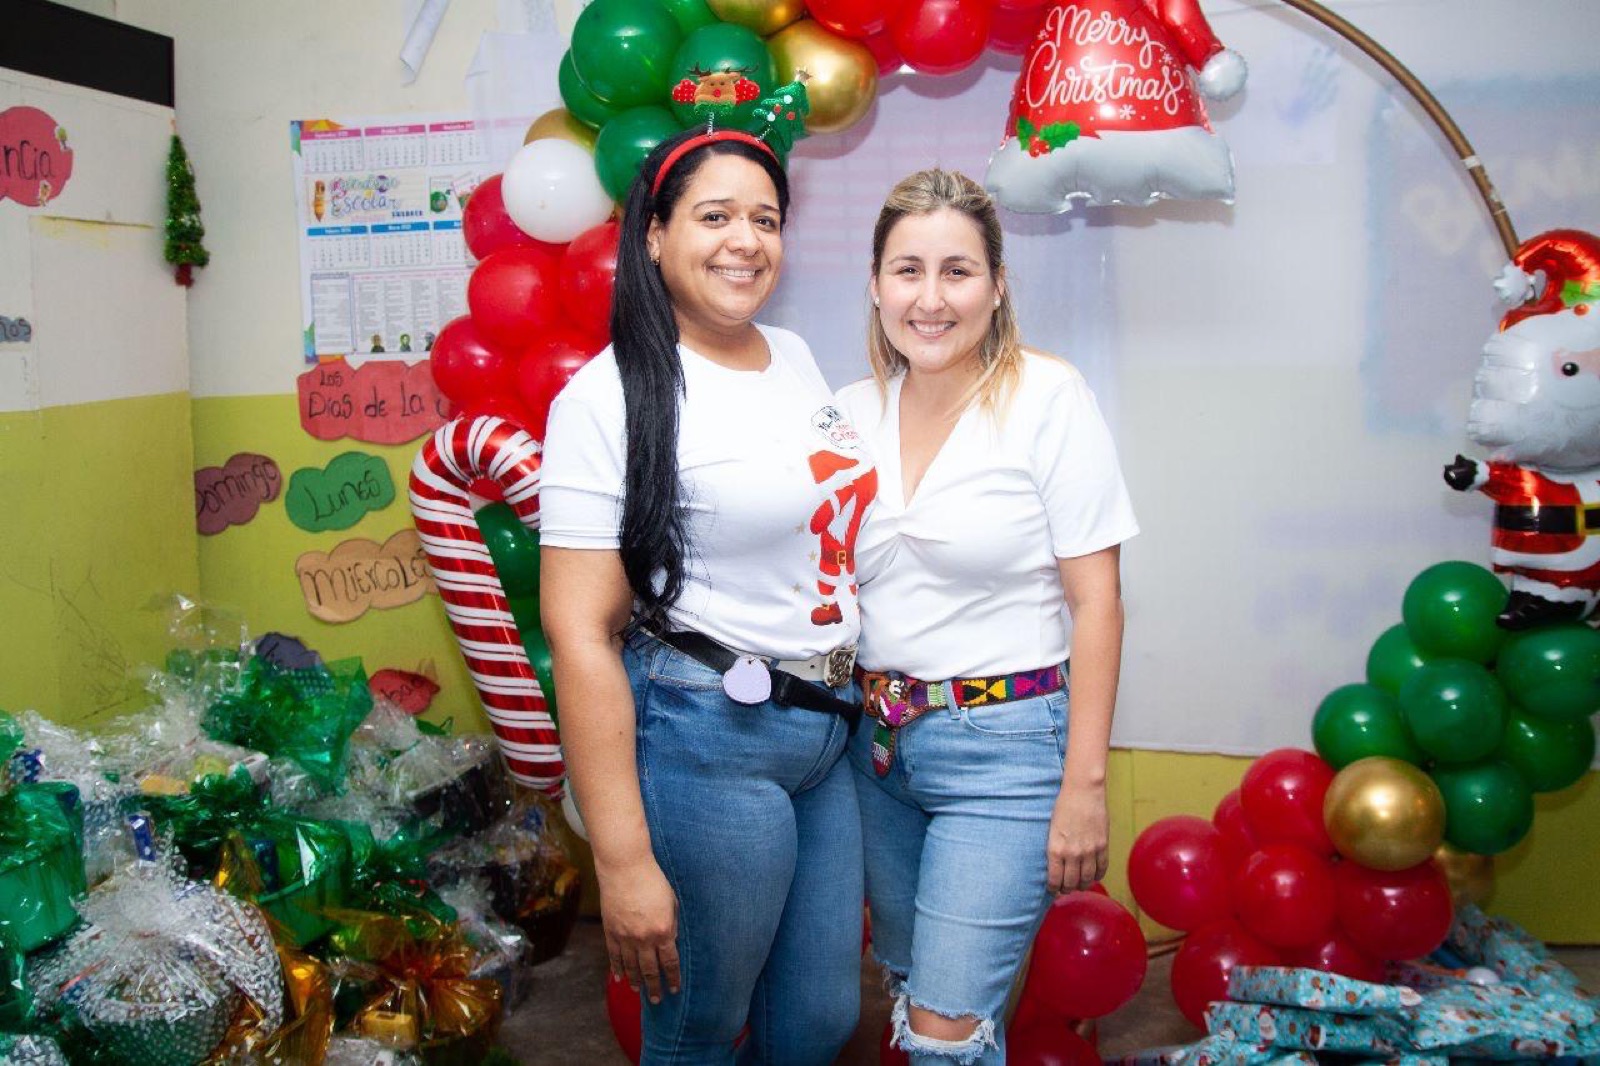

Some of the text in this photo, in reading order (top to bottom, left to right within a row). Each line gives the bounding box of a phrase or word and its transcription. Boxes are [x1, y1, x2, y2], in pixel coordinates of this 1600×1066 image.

[1046, 5, 1167, 69] Merry
[1026, 41, 1185, 115] Christmas
[364, 385, 389, 417] de
[303, 469, 381, 521] Lunes
